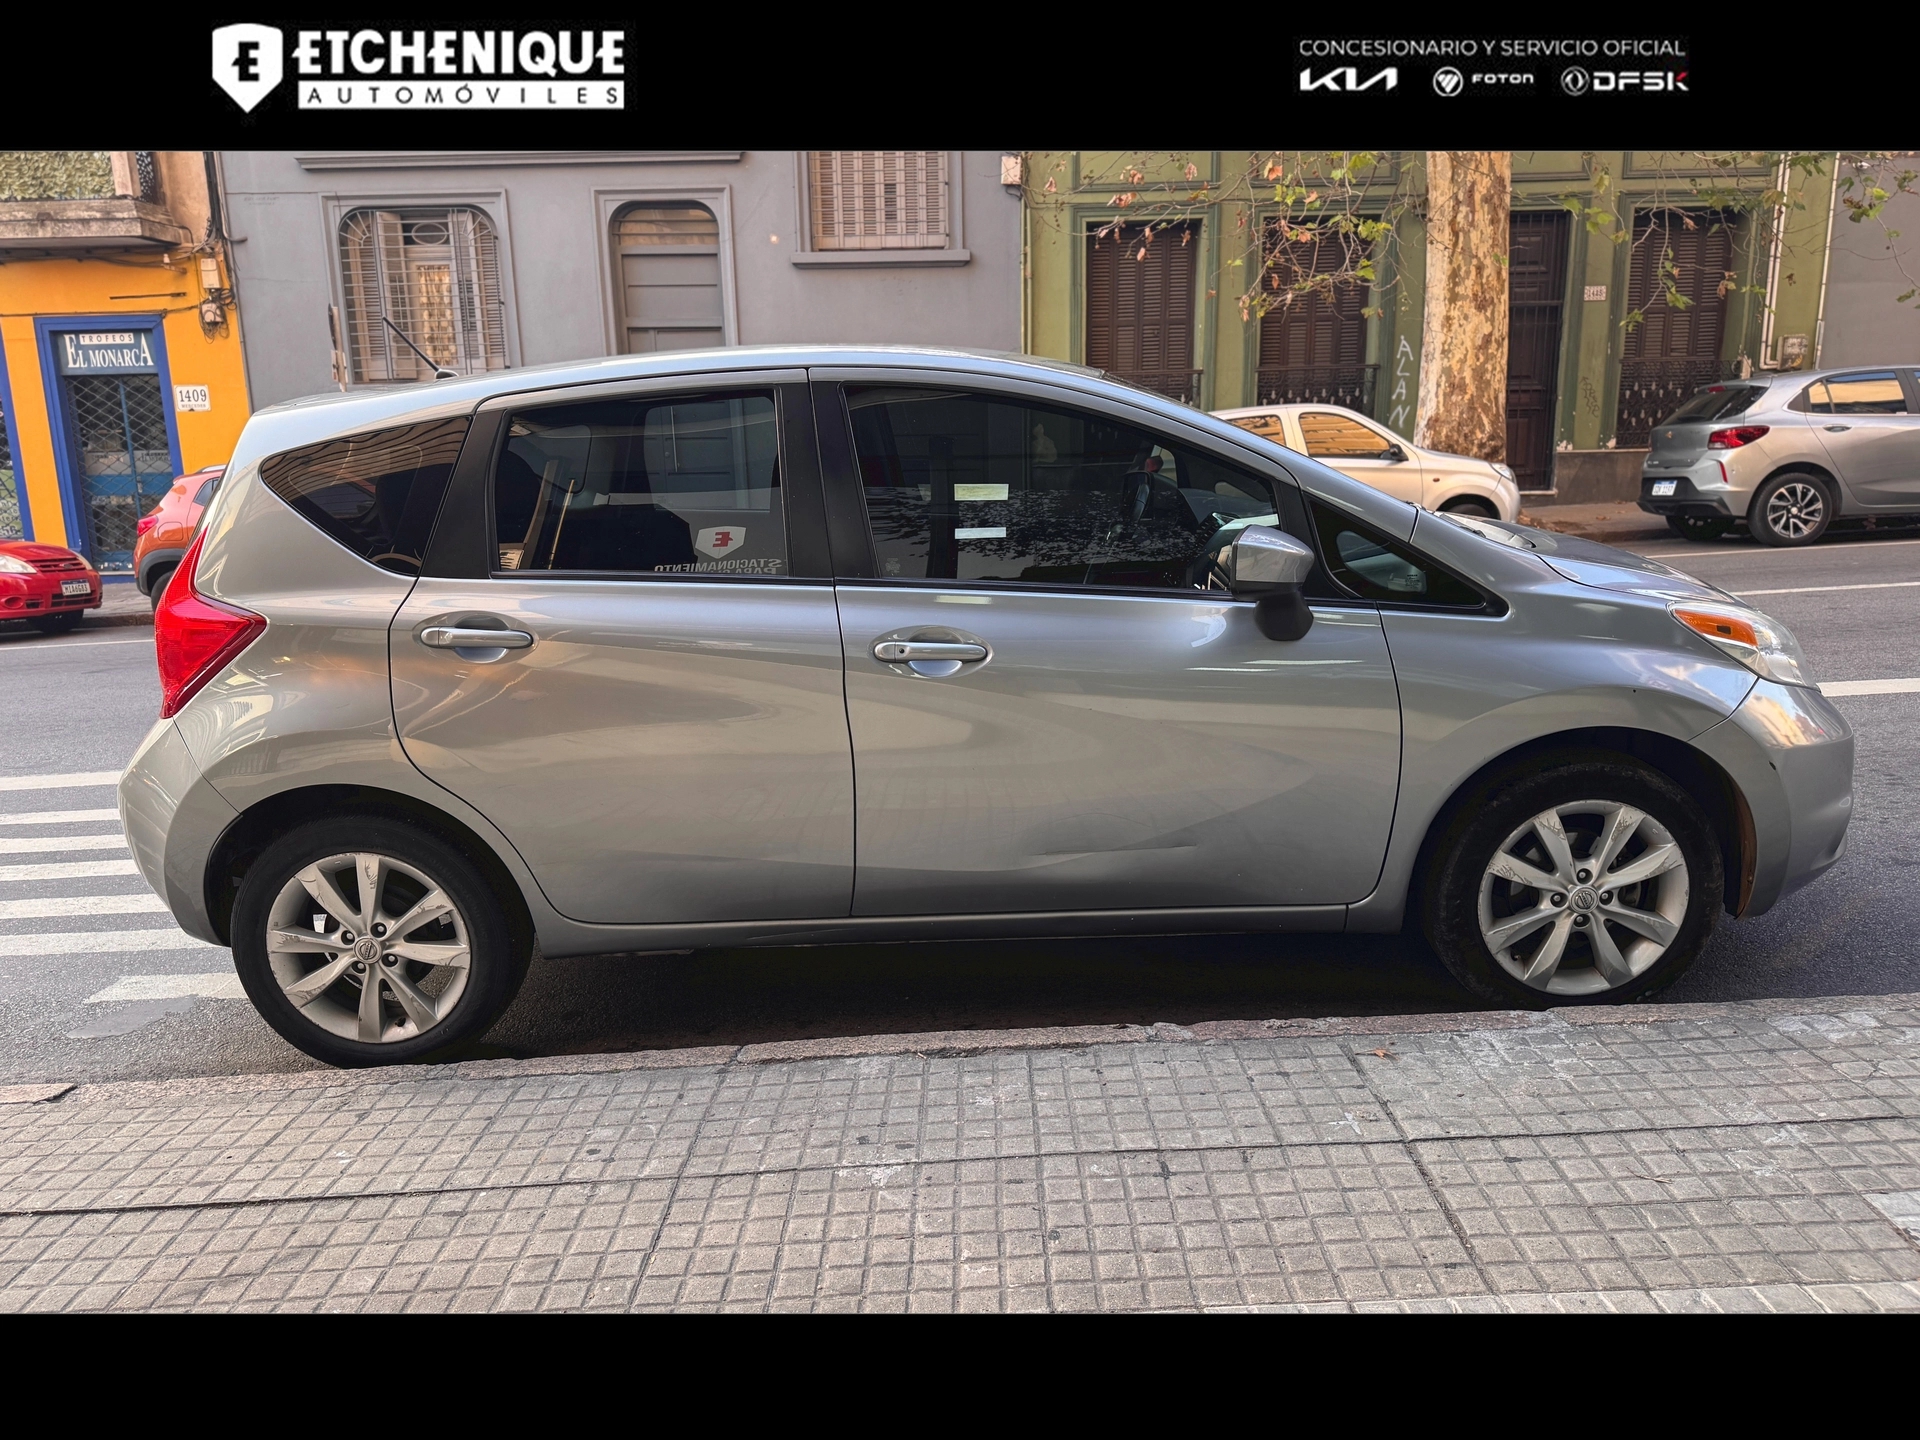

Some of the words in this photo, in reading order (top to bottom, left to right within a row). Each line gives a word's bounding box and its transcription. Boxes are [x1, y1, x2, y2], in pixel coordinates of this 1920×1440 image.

[81, 334, 133, 343] TROFEOS
[89, 332, 154, 367] MONARCA
[1388, 335, 1414, 428] ALAN
[178, 388, 207, 402] 1409
